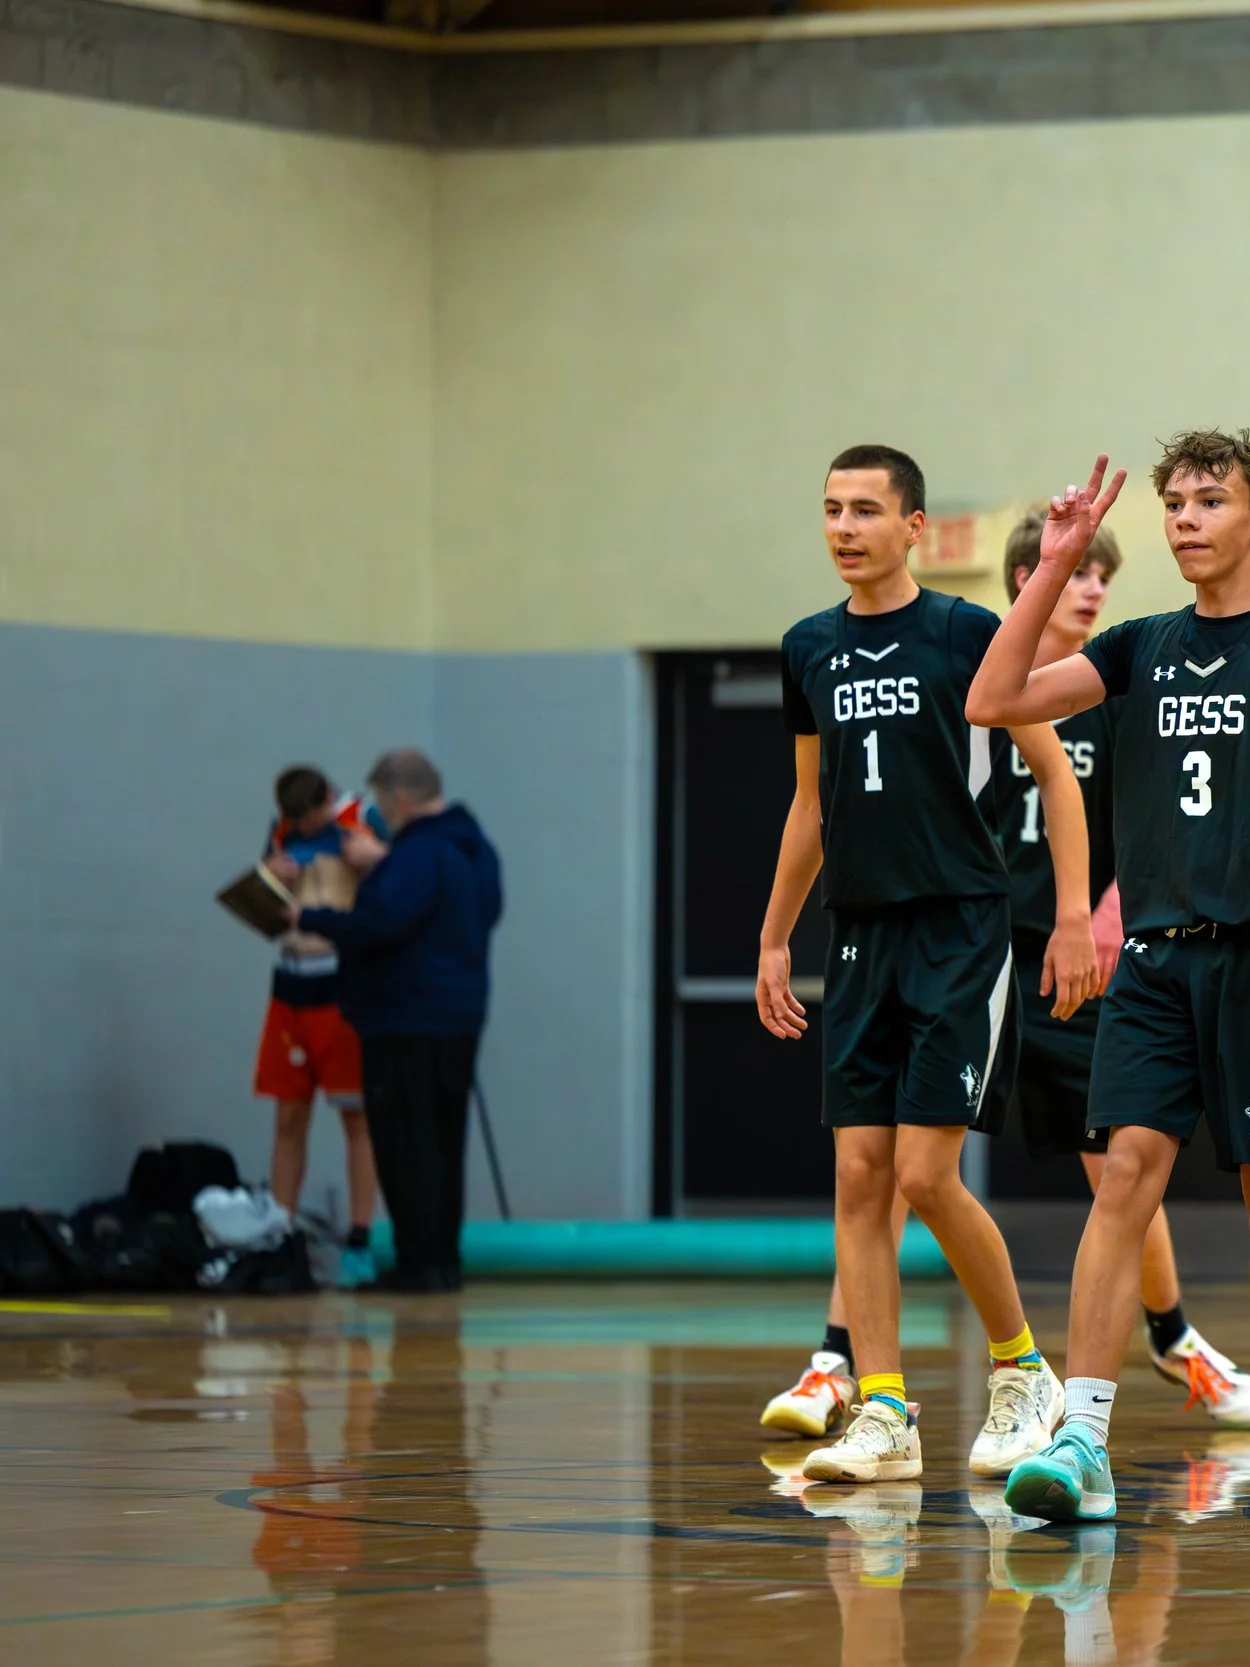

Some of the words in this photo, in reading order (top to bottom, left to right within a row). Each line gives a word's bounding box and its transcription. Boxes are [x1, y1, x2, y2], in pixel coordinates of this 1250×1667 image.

[834, 677, 920, 722] GESS
[1158, 694, 1246, 738] GESS
[863, 729, 883, 792] 1
[1180, 750, 1212, 817] 3
